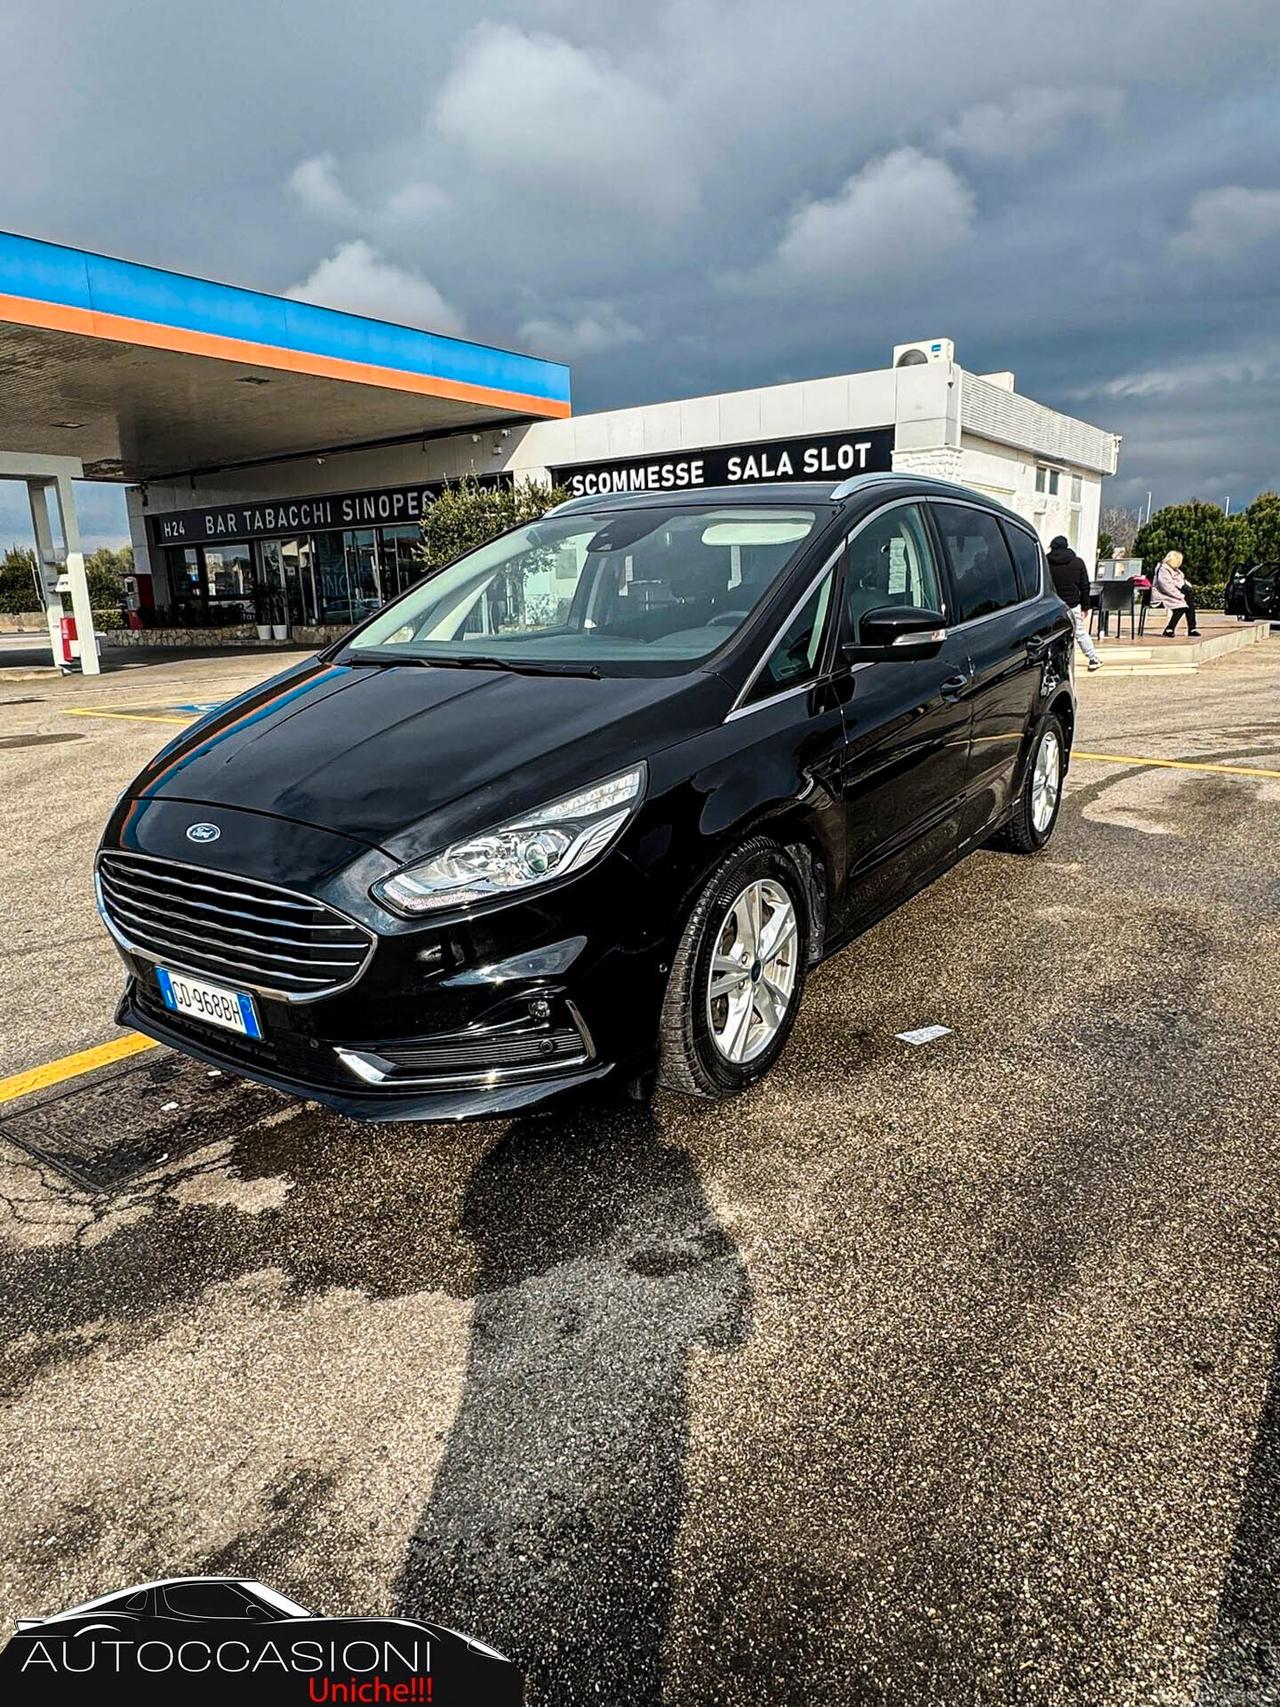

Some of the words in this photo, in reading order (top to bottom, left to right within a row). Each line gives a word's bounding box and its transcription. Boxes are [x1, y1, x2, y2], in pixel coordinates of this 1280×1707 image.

[572, 460, 704, 496] SCOMMESSE
[727, 450, 794, 481] SALA
[803, 442, 872, 474] SLOT
[163, 520, 185, 537] H24
[205, 513, 237, 535] BAR
[243, 501, 331, 531] TABACCHI
